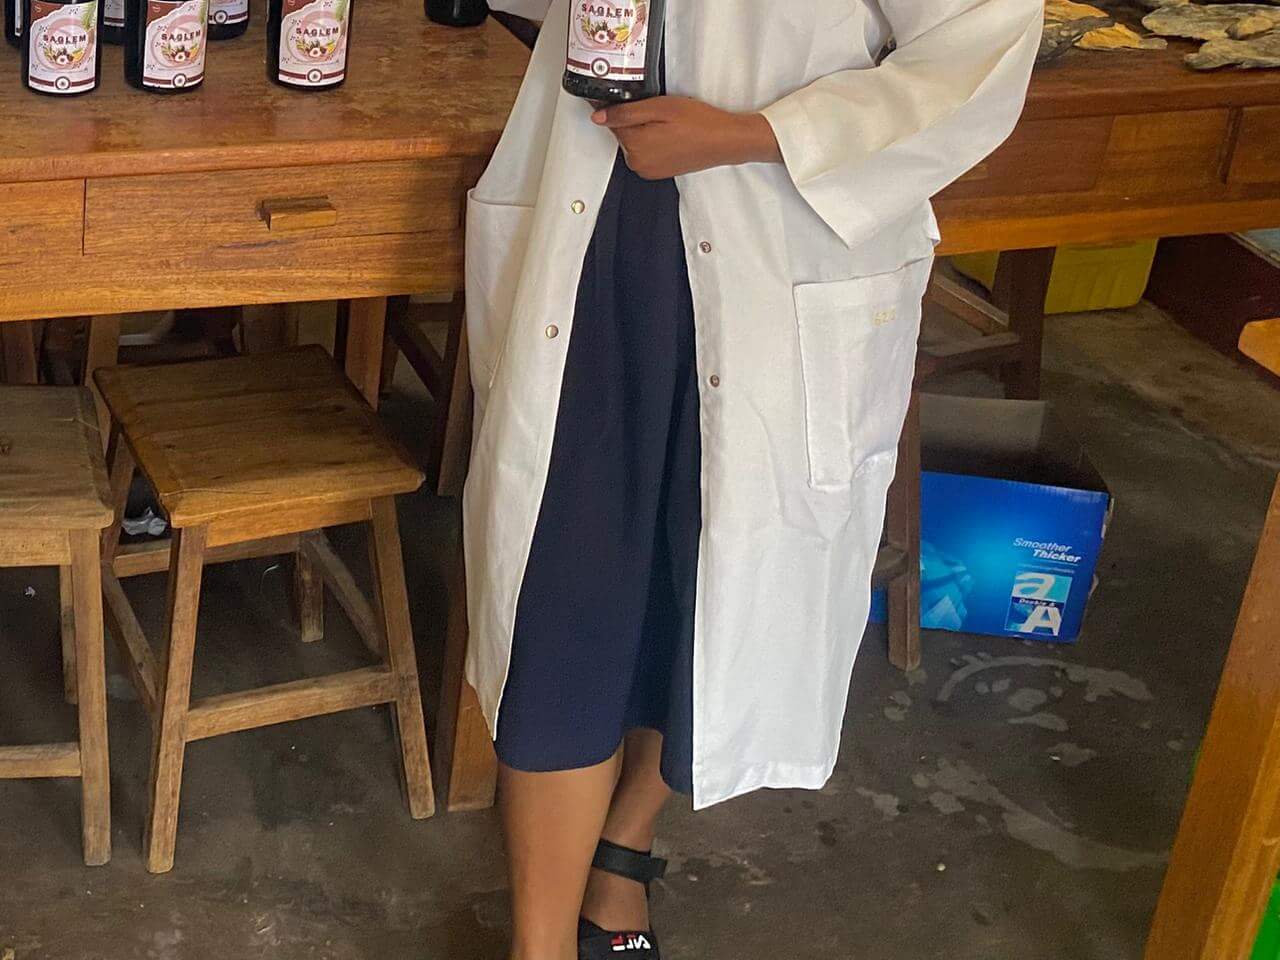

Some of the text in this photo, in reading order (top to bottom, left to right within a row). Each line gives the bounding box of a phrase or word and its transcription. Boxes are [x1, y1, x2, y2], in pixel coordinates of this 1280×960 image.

[581, 3, 634, 18] SAGLEM
[161, 29, 201, 41] SAGLEM
[296, 27, 339, 37] SAGLEM
[42, 34, 87, 45] SAGLEM
[1013, 537, 1073, 552] Smoother
[1032, 549, 1082, 562] Thicker
